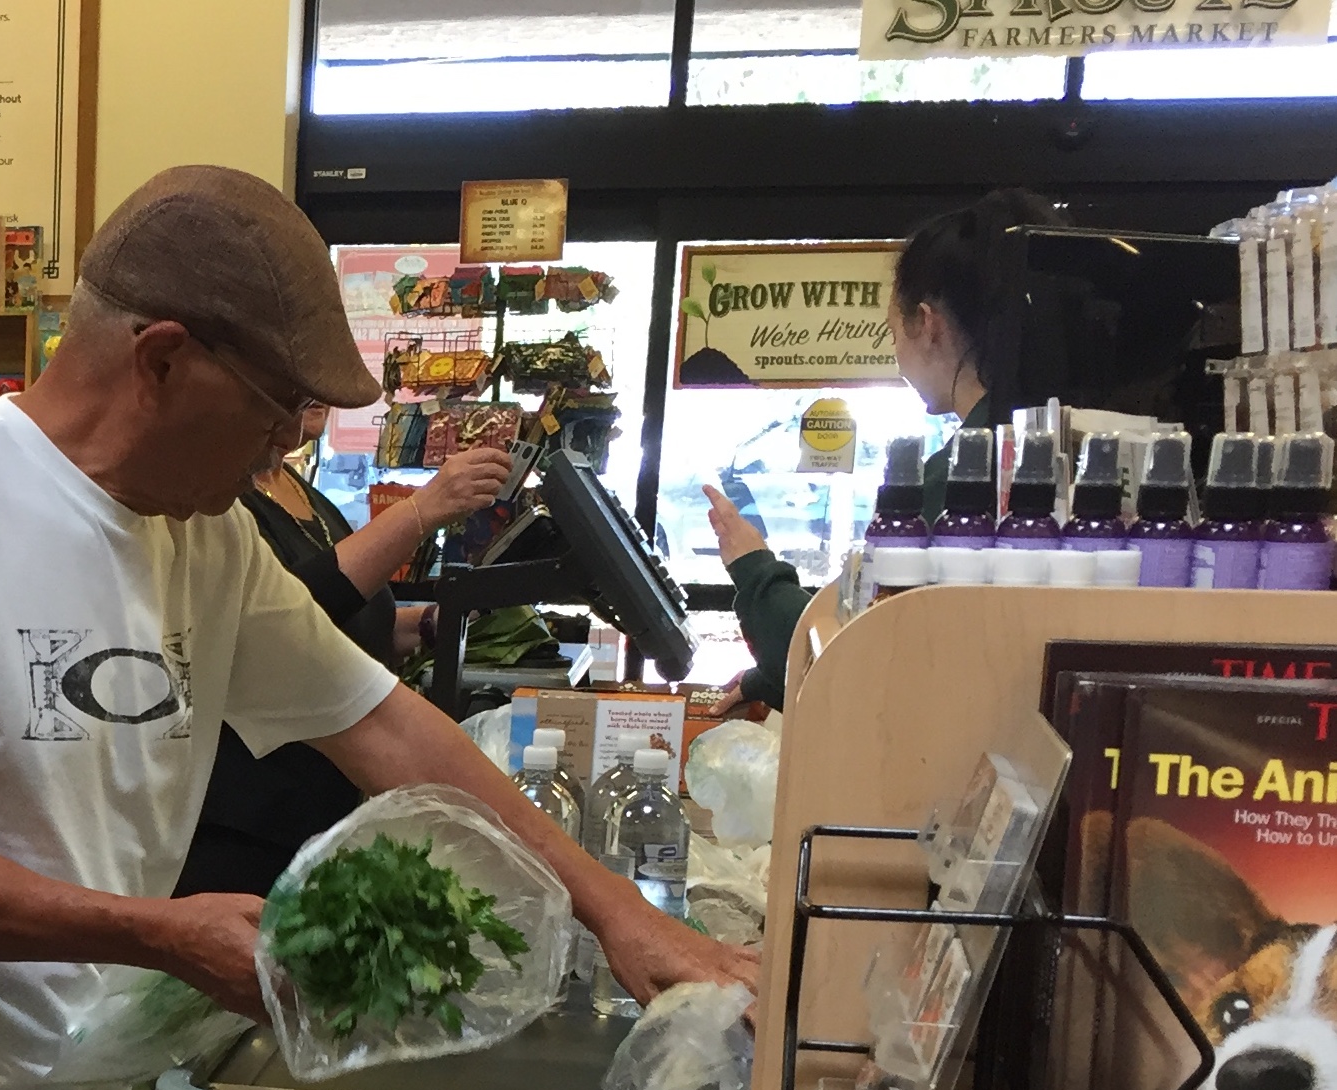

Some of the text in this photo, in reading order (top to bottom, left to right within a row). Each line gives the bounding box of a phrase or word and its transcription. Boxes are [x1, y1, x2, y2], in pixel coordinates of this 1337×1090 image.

[962, 24, 1116, 47] FARMERS
[1130, 21, 1279, 43] MARKET
[708, 280, 882, 318] GROW WITH
[750, 322, 810, 348] We're
[754, 351, 896, 370] sprouts.com/careers
[806, 420, 851, 429] CAUTION
[1148, 753, 1244, 801] The
[1234, 808, 1271, 825] How
[1275, 810, 1313, 831] They
[1256, 828, 1293, 845] How
[1297, 831, 1314, 846] to
